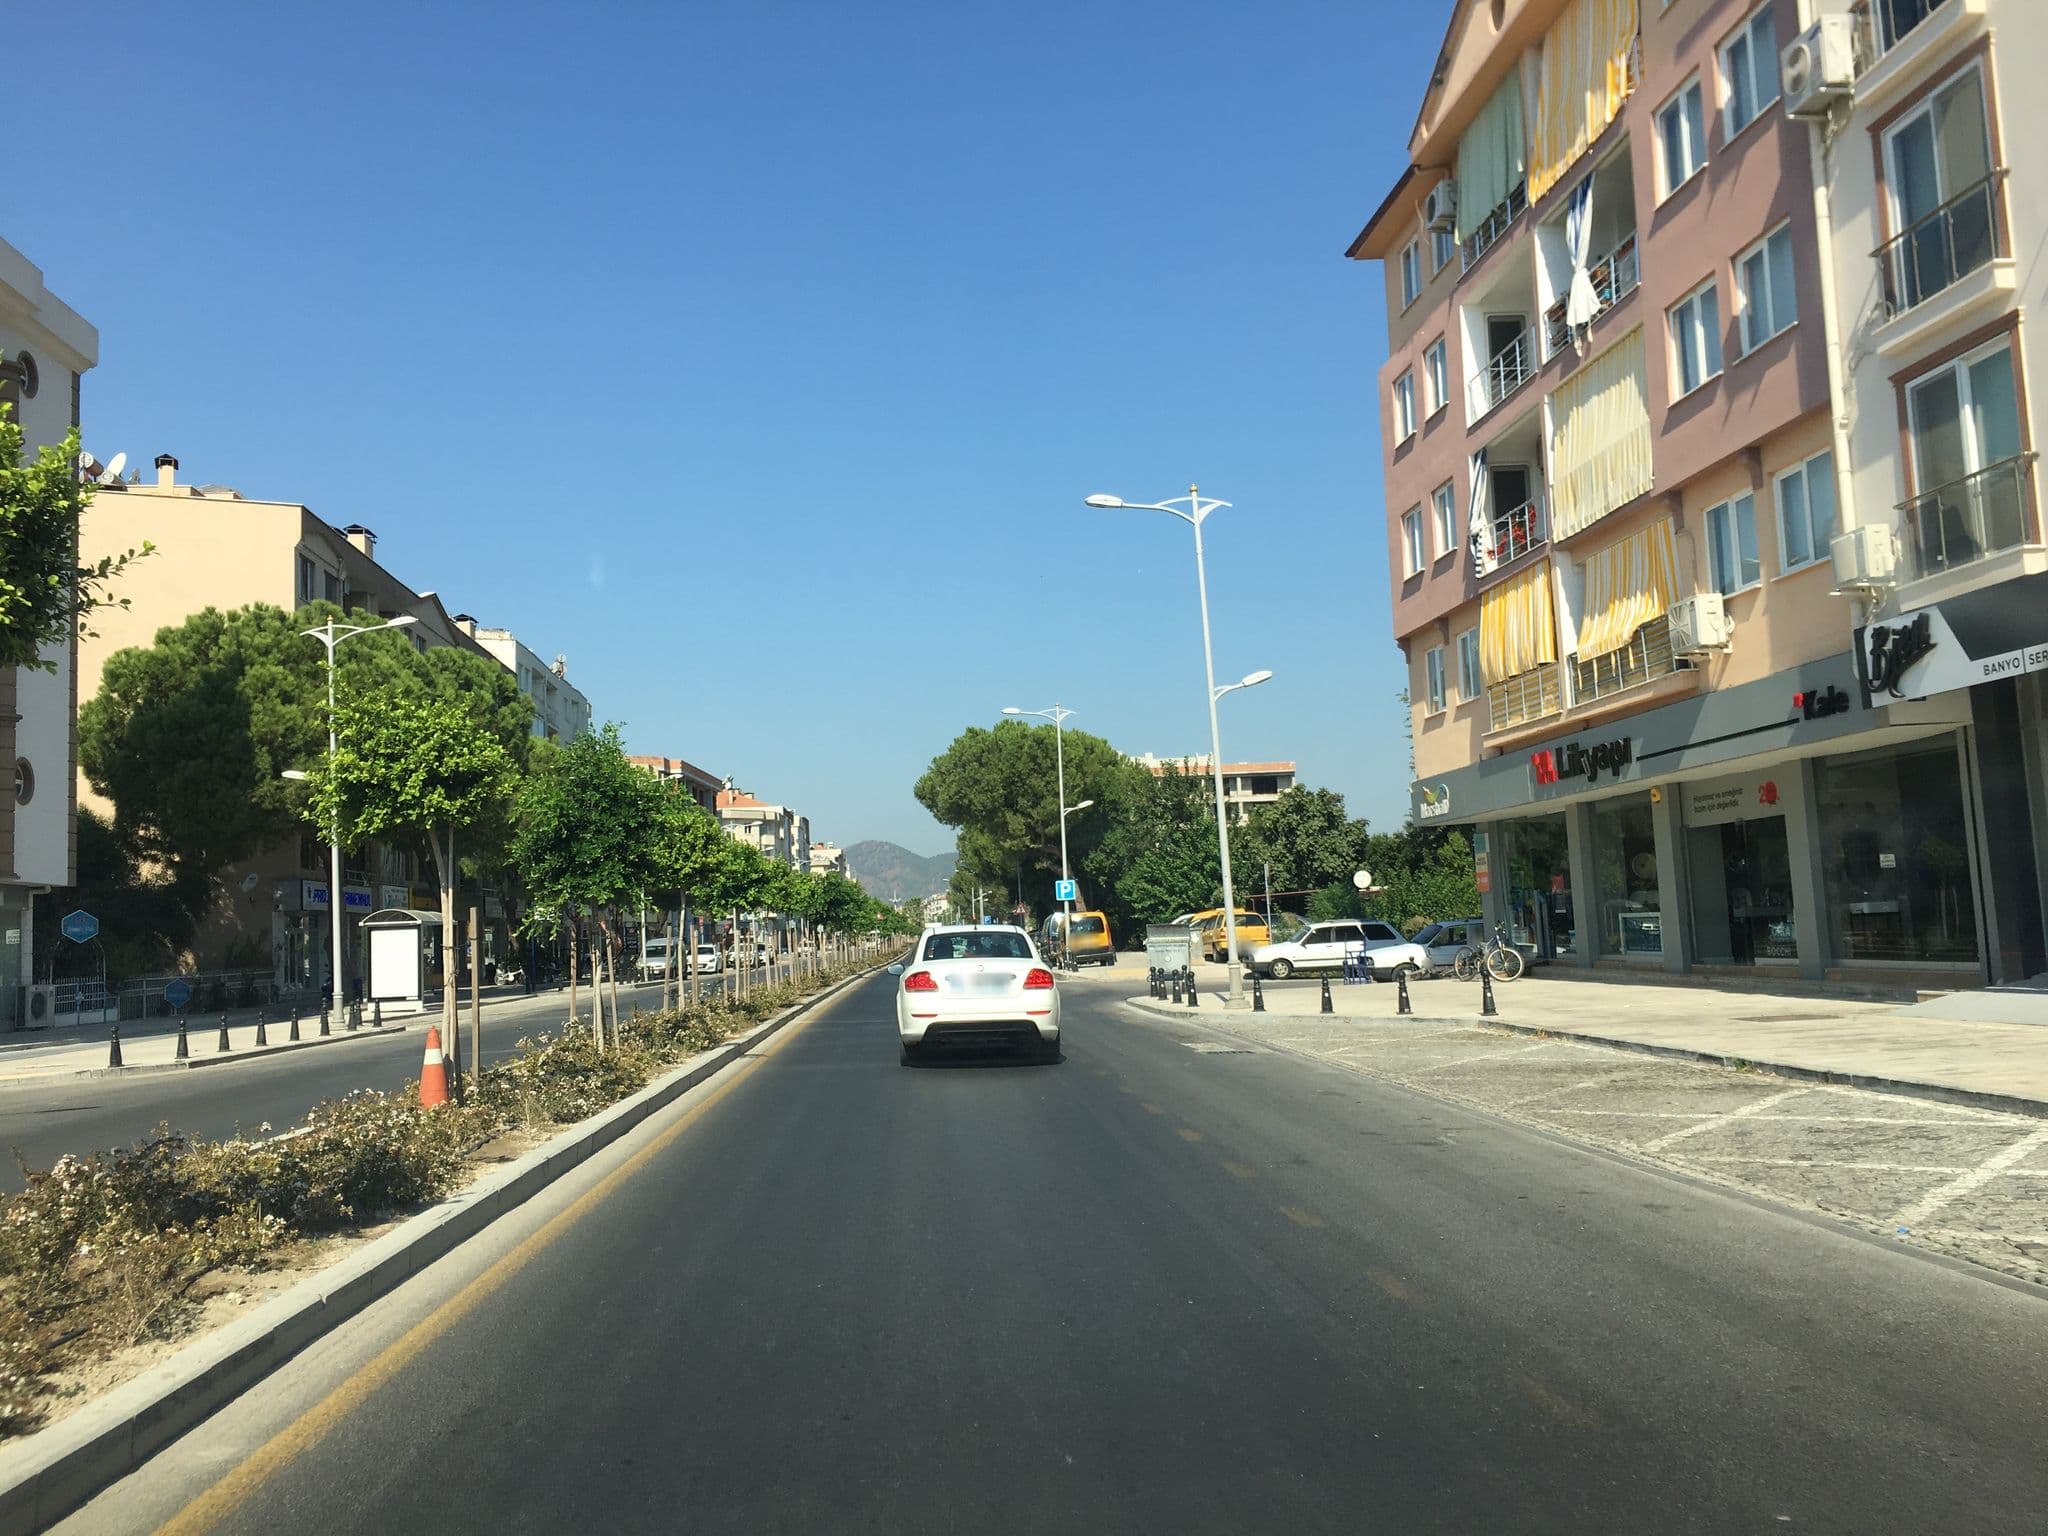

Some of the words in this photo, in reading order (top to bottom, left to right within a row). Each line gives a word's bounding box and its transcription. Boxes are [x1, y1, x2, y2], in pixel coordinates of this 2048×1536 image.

[1983, 657, 2021, 676] BANYO
[1803, 685, 1850, 720] Kale
[1061, 884, 1071, 899] P
